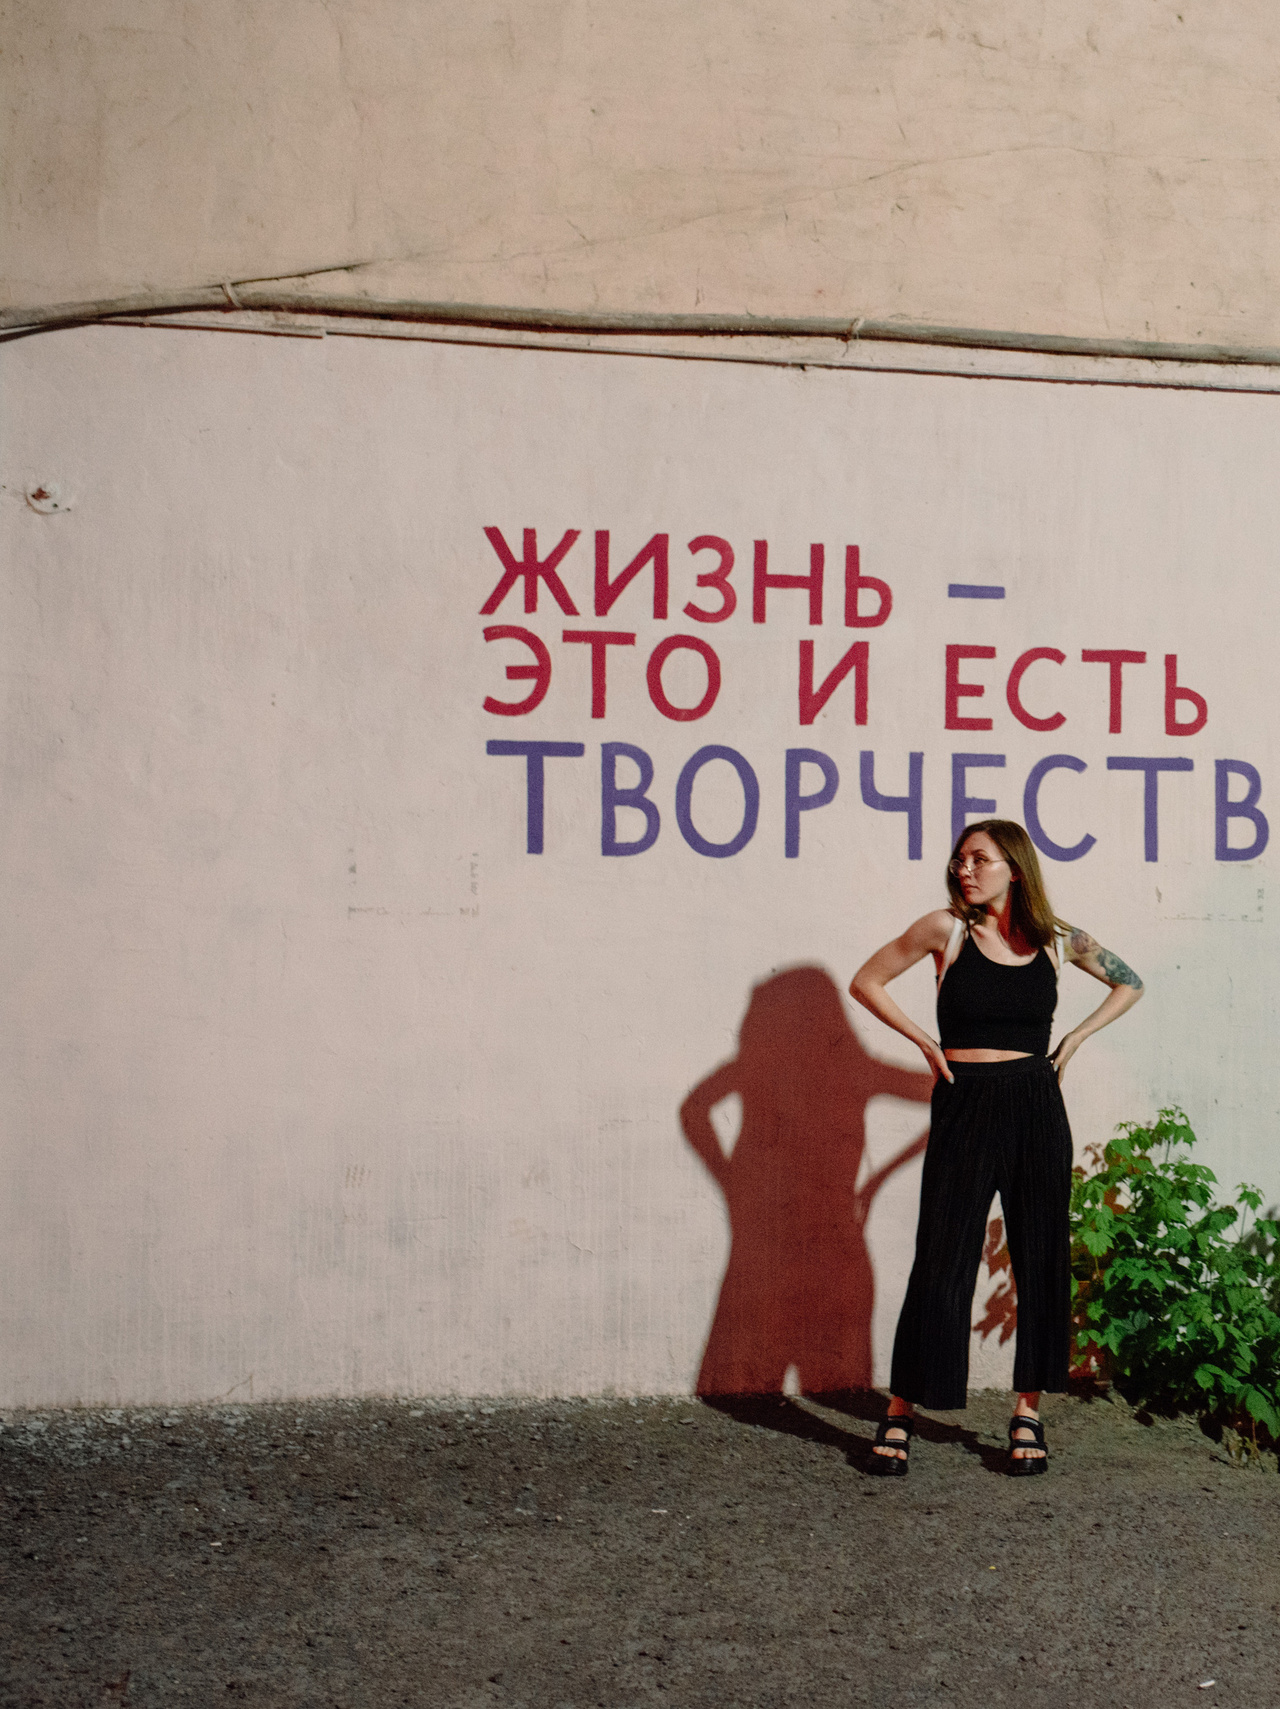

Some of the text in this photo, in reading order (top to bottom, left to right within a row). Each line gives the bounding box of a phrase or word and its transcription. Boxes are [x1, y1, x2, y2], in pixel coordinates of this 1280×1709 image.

[479, 526, 893, 628] ЖИЗНЬ
[482, 625, 1208, 737] ЭТО И ЕСТЬ
